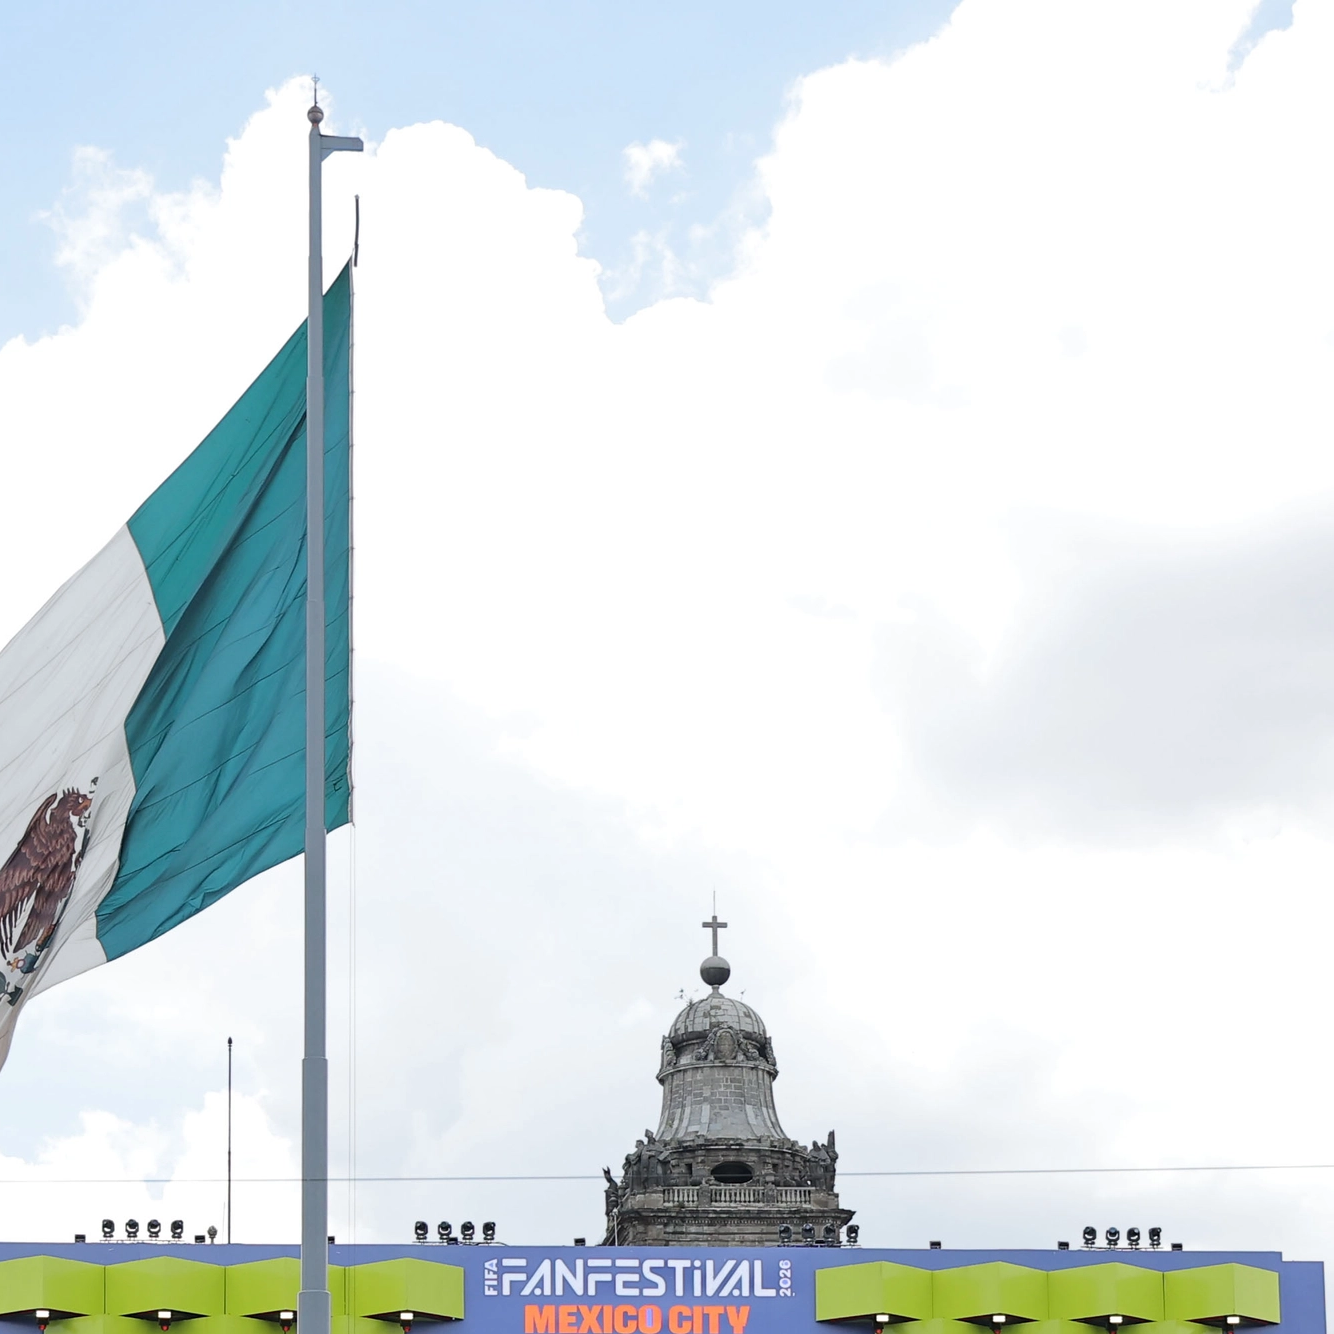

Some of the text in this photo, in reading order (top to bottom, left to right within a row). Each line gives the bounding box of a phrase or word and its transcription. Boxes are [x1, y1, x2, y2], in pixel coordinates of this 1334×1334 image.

[484, 1258, 498, 1296] FIFA
[779, 1259, 792, 1297] 2026
[524, 1304, 751, 1334] MEXICO CITY
